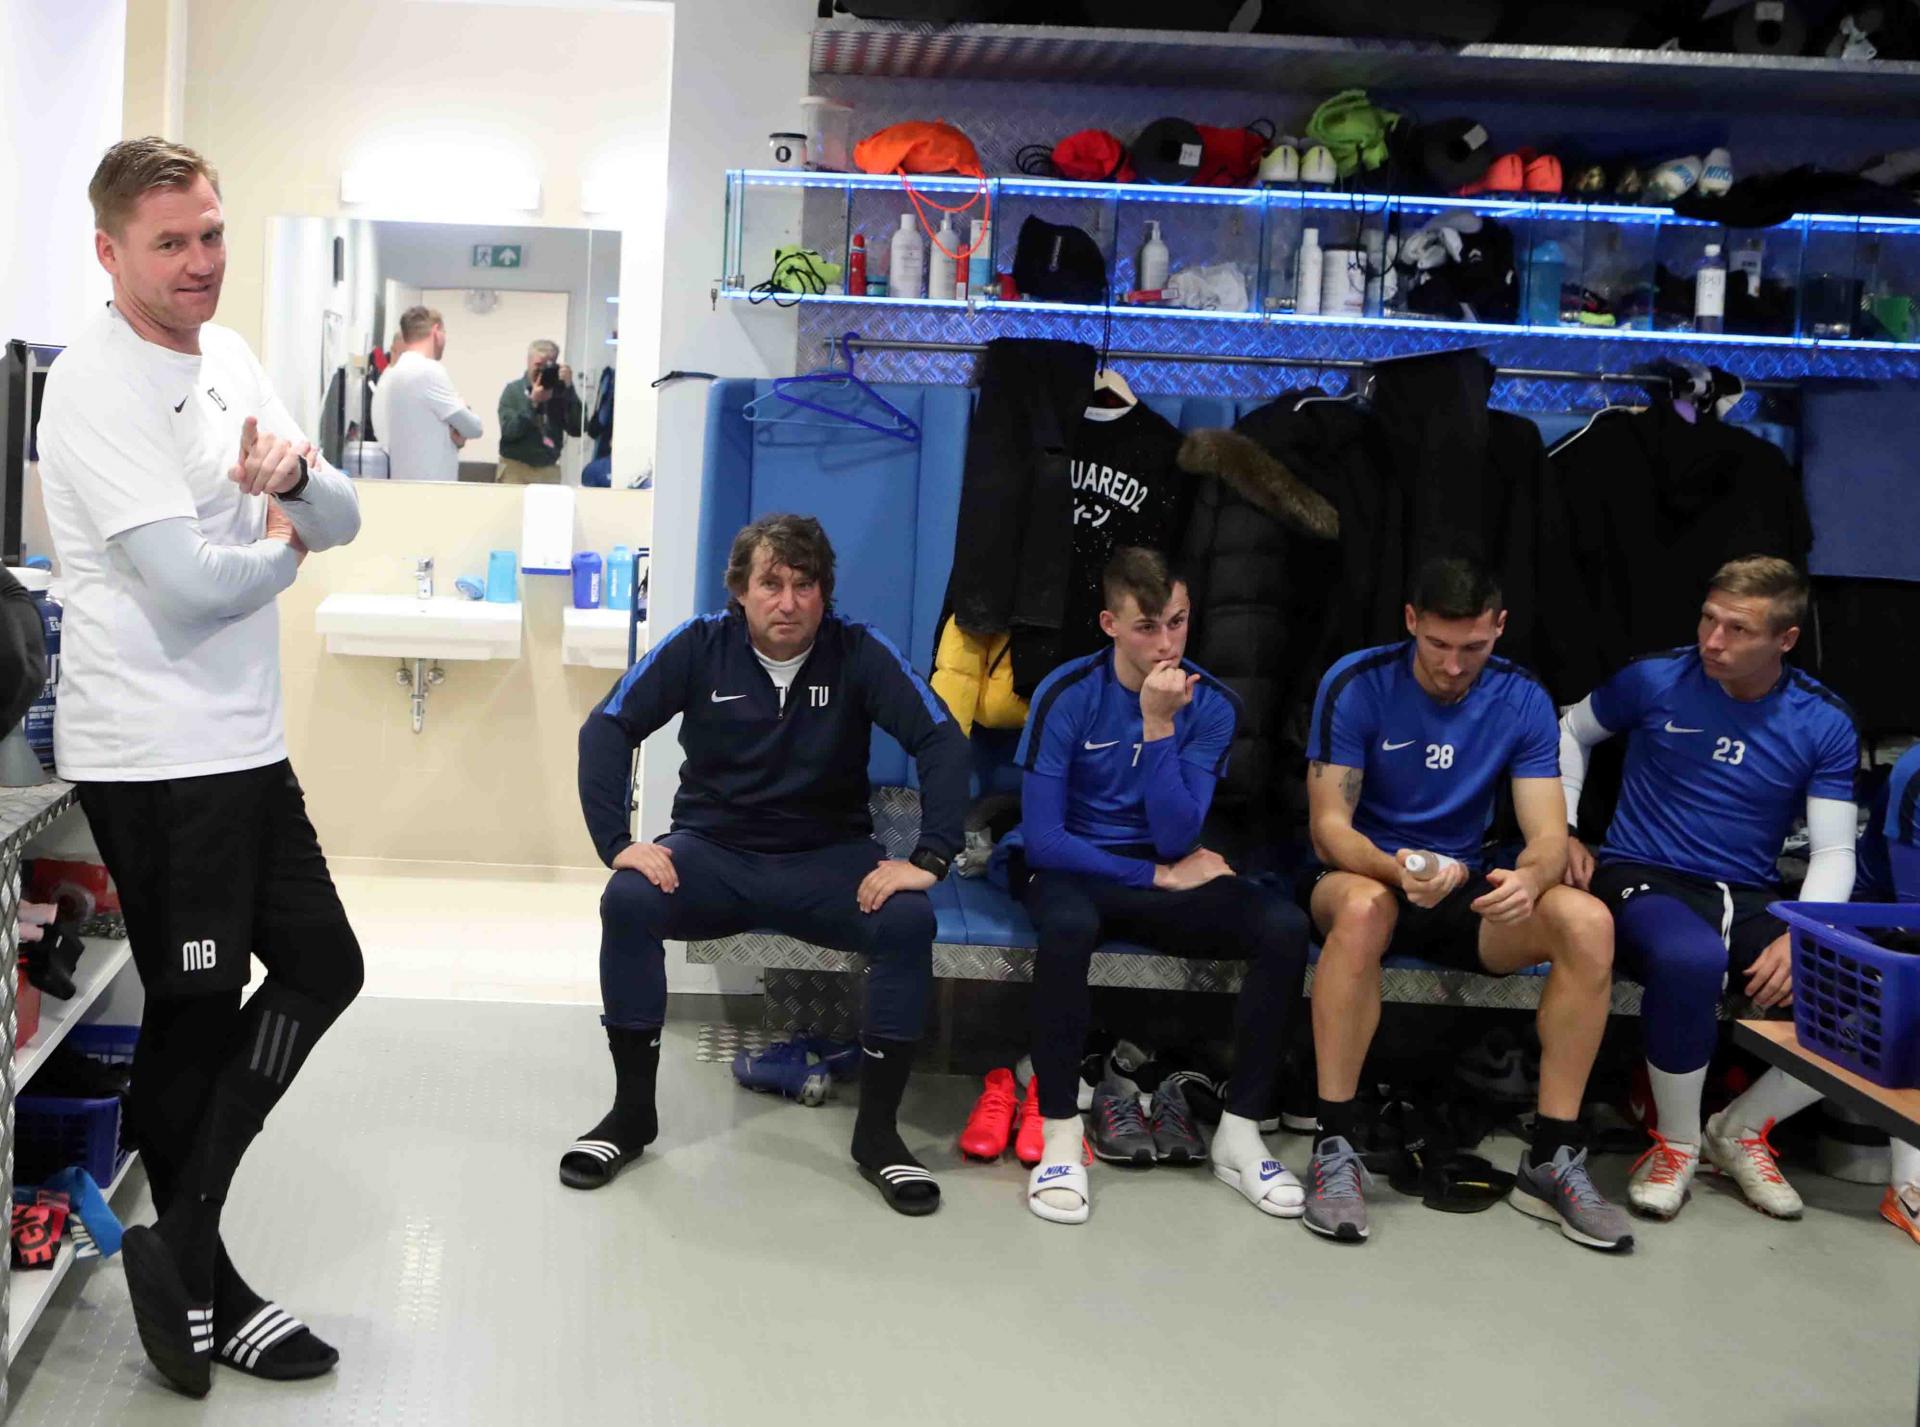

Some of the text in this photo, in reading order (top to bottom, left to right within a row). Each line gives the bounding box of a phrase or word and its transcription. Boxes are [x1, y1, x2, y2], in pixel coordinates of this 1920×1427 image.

[1070, 459, 1149, 514] UARED2
[808, 685, 829, 707] TU
[1132, 743, 1142, 767] 7
[1425, 743, 1454, 769] 28
[1712, 736, 1746, 765] 23
[182, 939, 217, 972] MB
[1044, 1165, 1073, 1177] NIKE
[1262, 1160, 1282, 1172] NIKE
